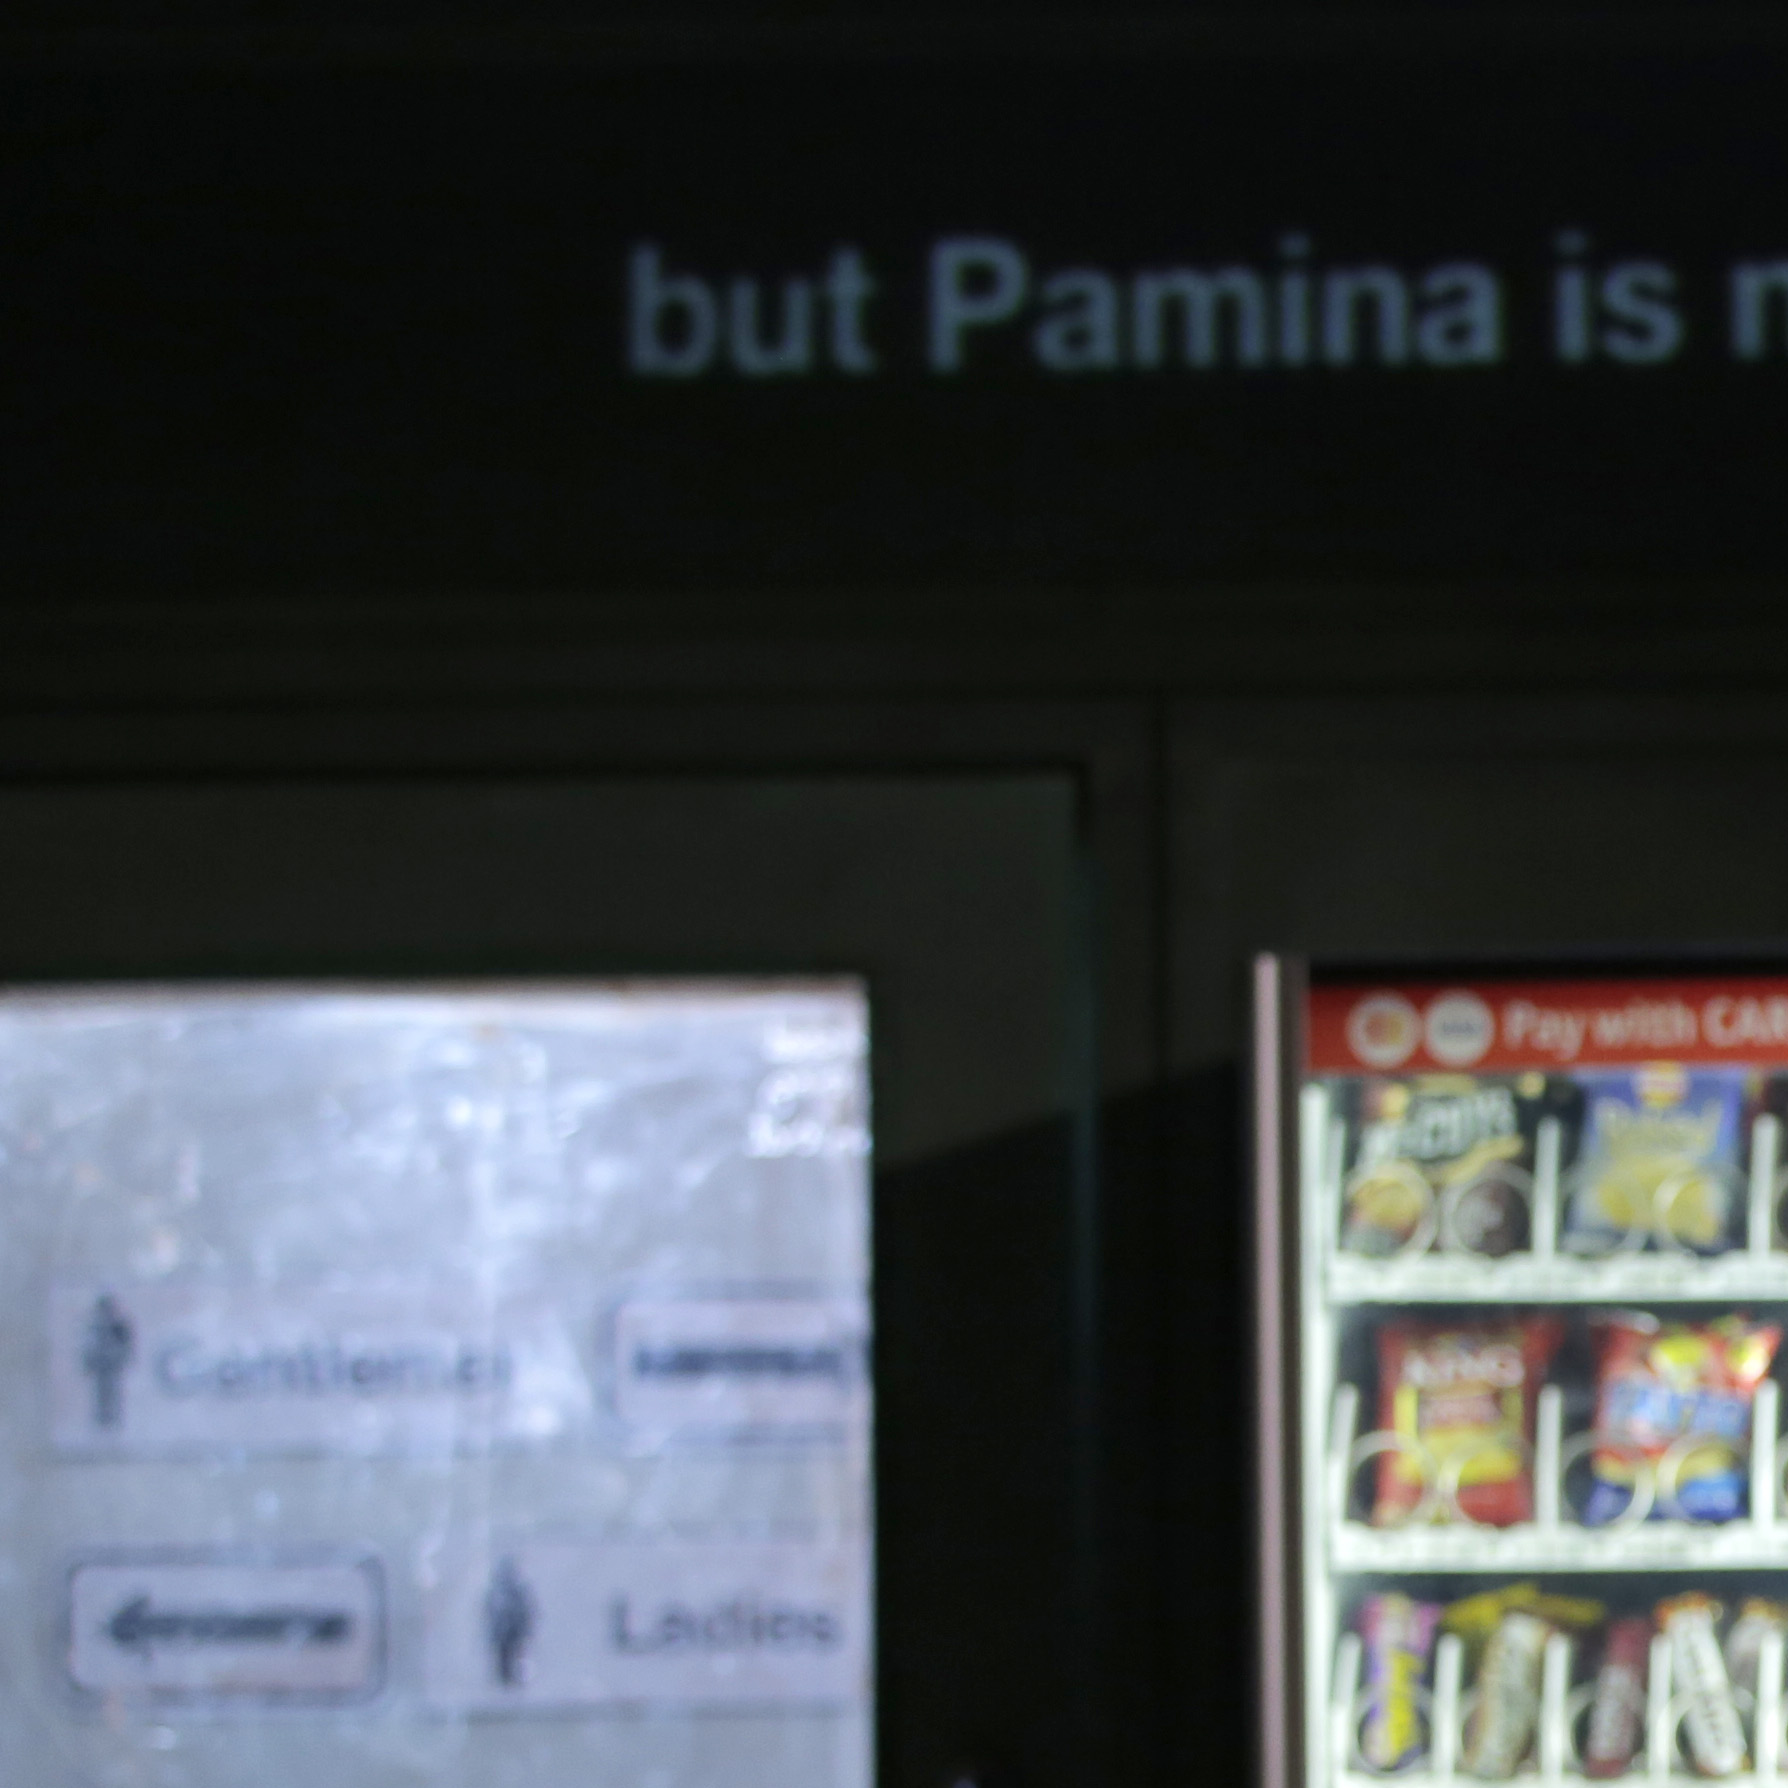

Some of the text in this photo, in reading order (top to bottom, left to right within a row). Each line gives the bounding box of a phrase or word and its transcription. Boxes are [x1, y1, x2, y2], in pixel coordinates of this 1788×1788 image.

[632, 246, 871, 375] but
[930, 236, 1501, 369] Pamina
[1557, 236, 1681, 362] is
[1504, 1000, 1582, 1060] Pay
[1590, 998, 1697, 1049] with
